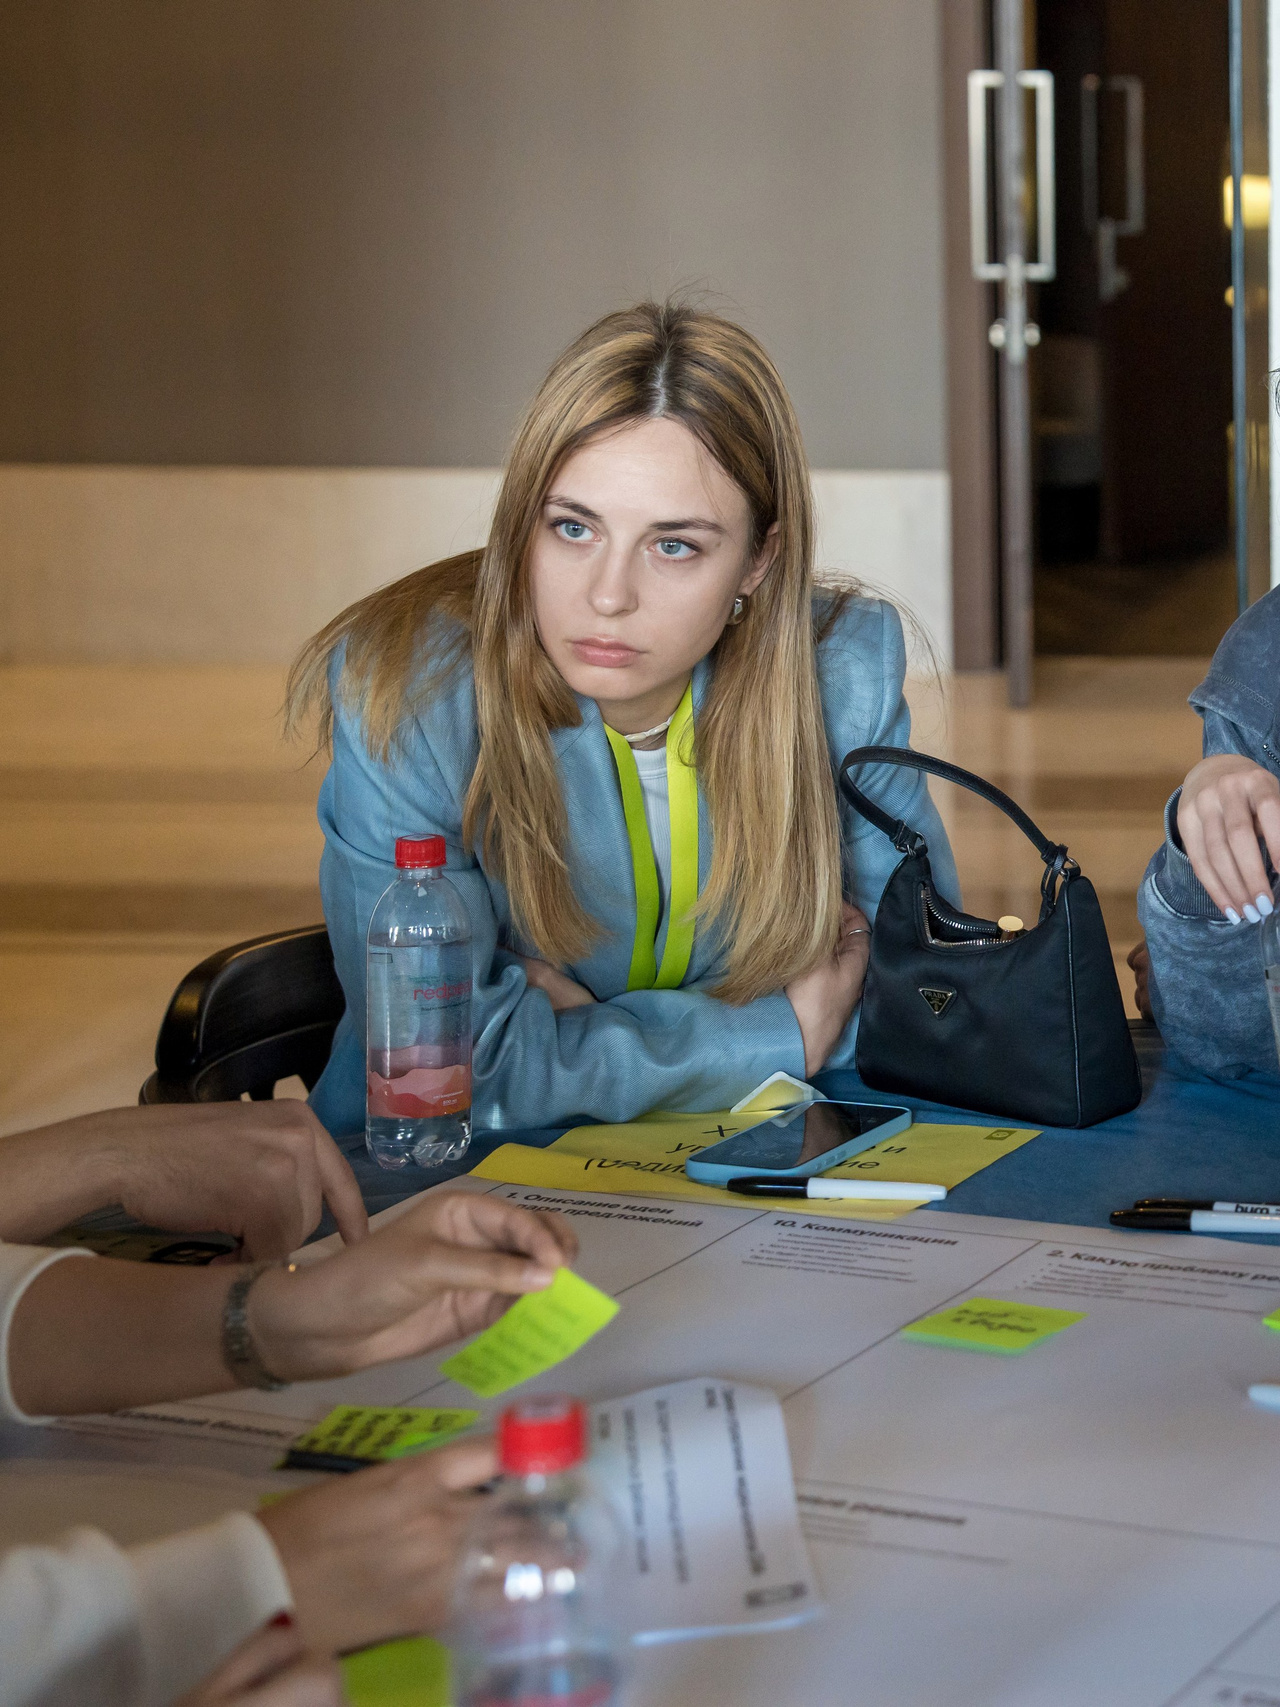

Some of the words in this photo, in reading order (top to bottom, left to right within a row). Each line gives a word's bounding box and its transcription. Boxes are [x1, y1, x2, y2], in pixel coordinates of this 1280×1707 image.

[923, 990, 947, 1000] PRADA
[524, 1194, 619, 1209] Описание
[622, 1204, 674, 1215] идеи
[563, 1207, 704, 1228] предложений
[773, 1219, 797, 1228] 10.
[801, 1222, 959, 1246] Коммуникации
[1070, 1252, 1138, 1268] Какую
[1142, 1261, 1250, 1279] проблему
